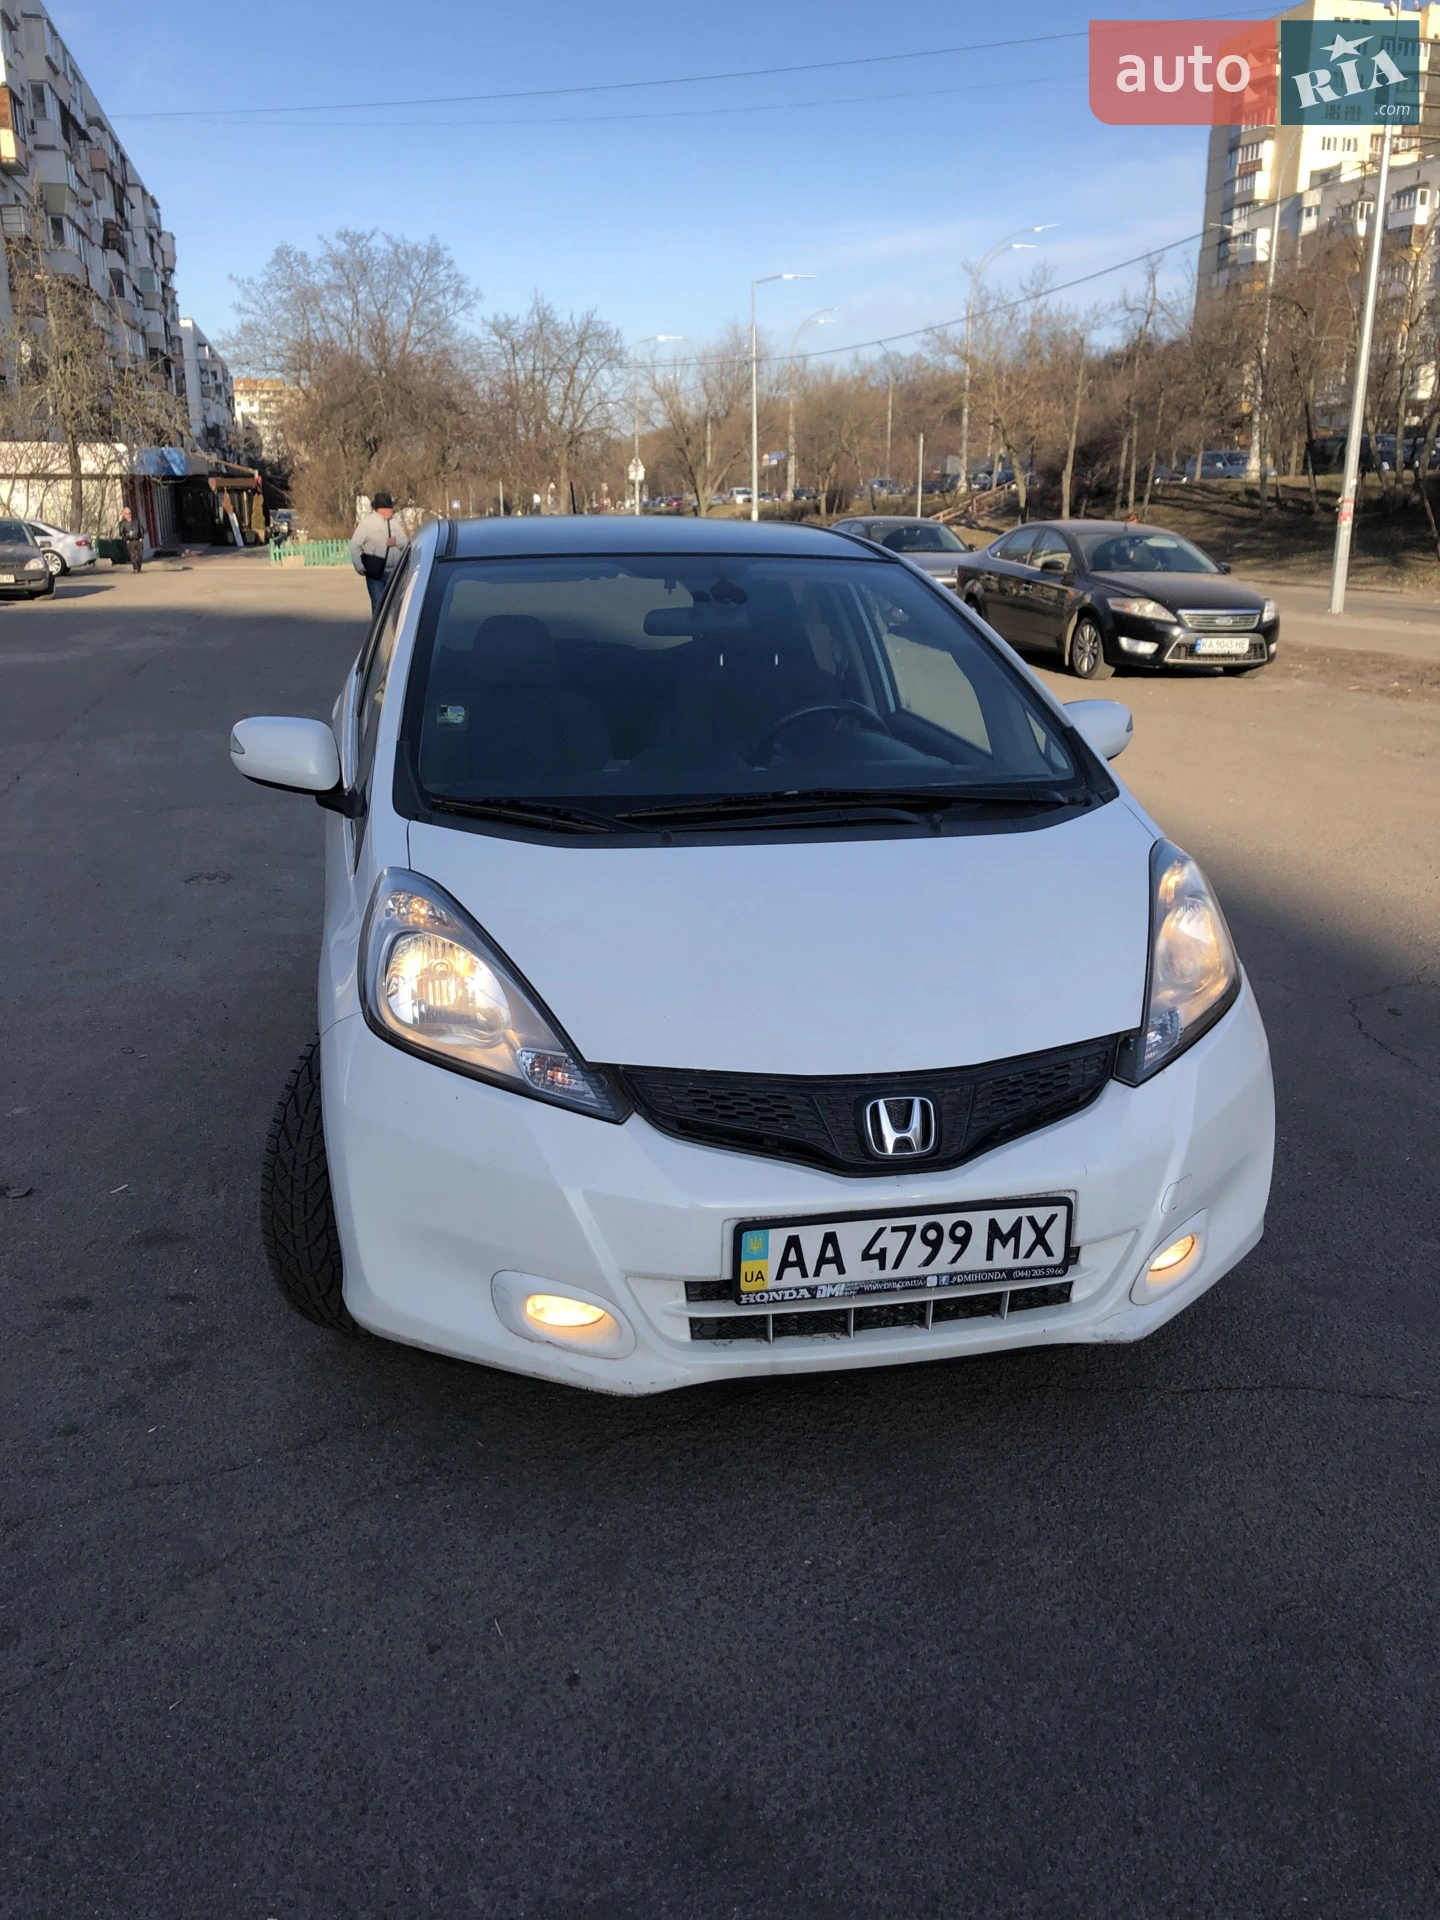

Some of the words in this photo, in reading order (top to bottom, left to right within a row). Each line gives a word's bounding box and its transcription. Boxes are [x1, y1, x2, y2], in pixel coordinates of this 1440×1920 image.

[775, 1231, 846, 1280] AA
[861, 1220, 972, 1271] 4799
[986, 1213, 1058, 1261] MX
[744, 1270, 765, 1283] UA
[740, 1288, 811, 1303] HONDA
[816, 1283, 845, 1298] DMI
